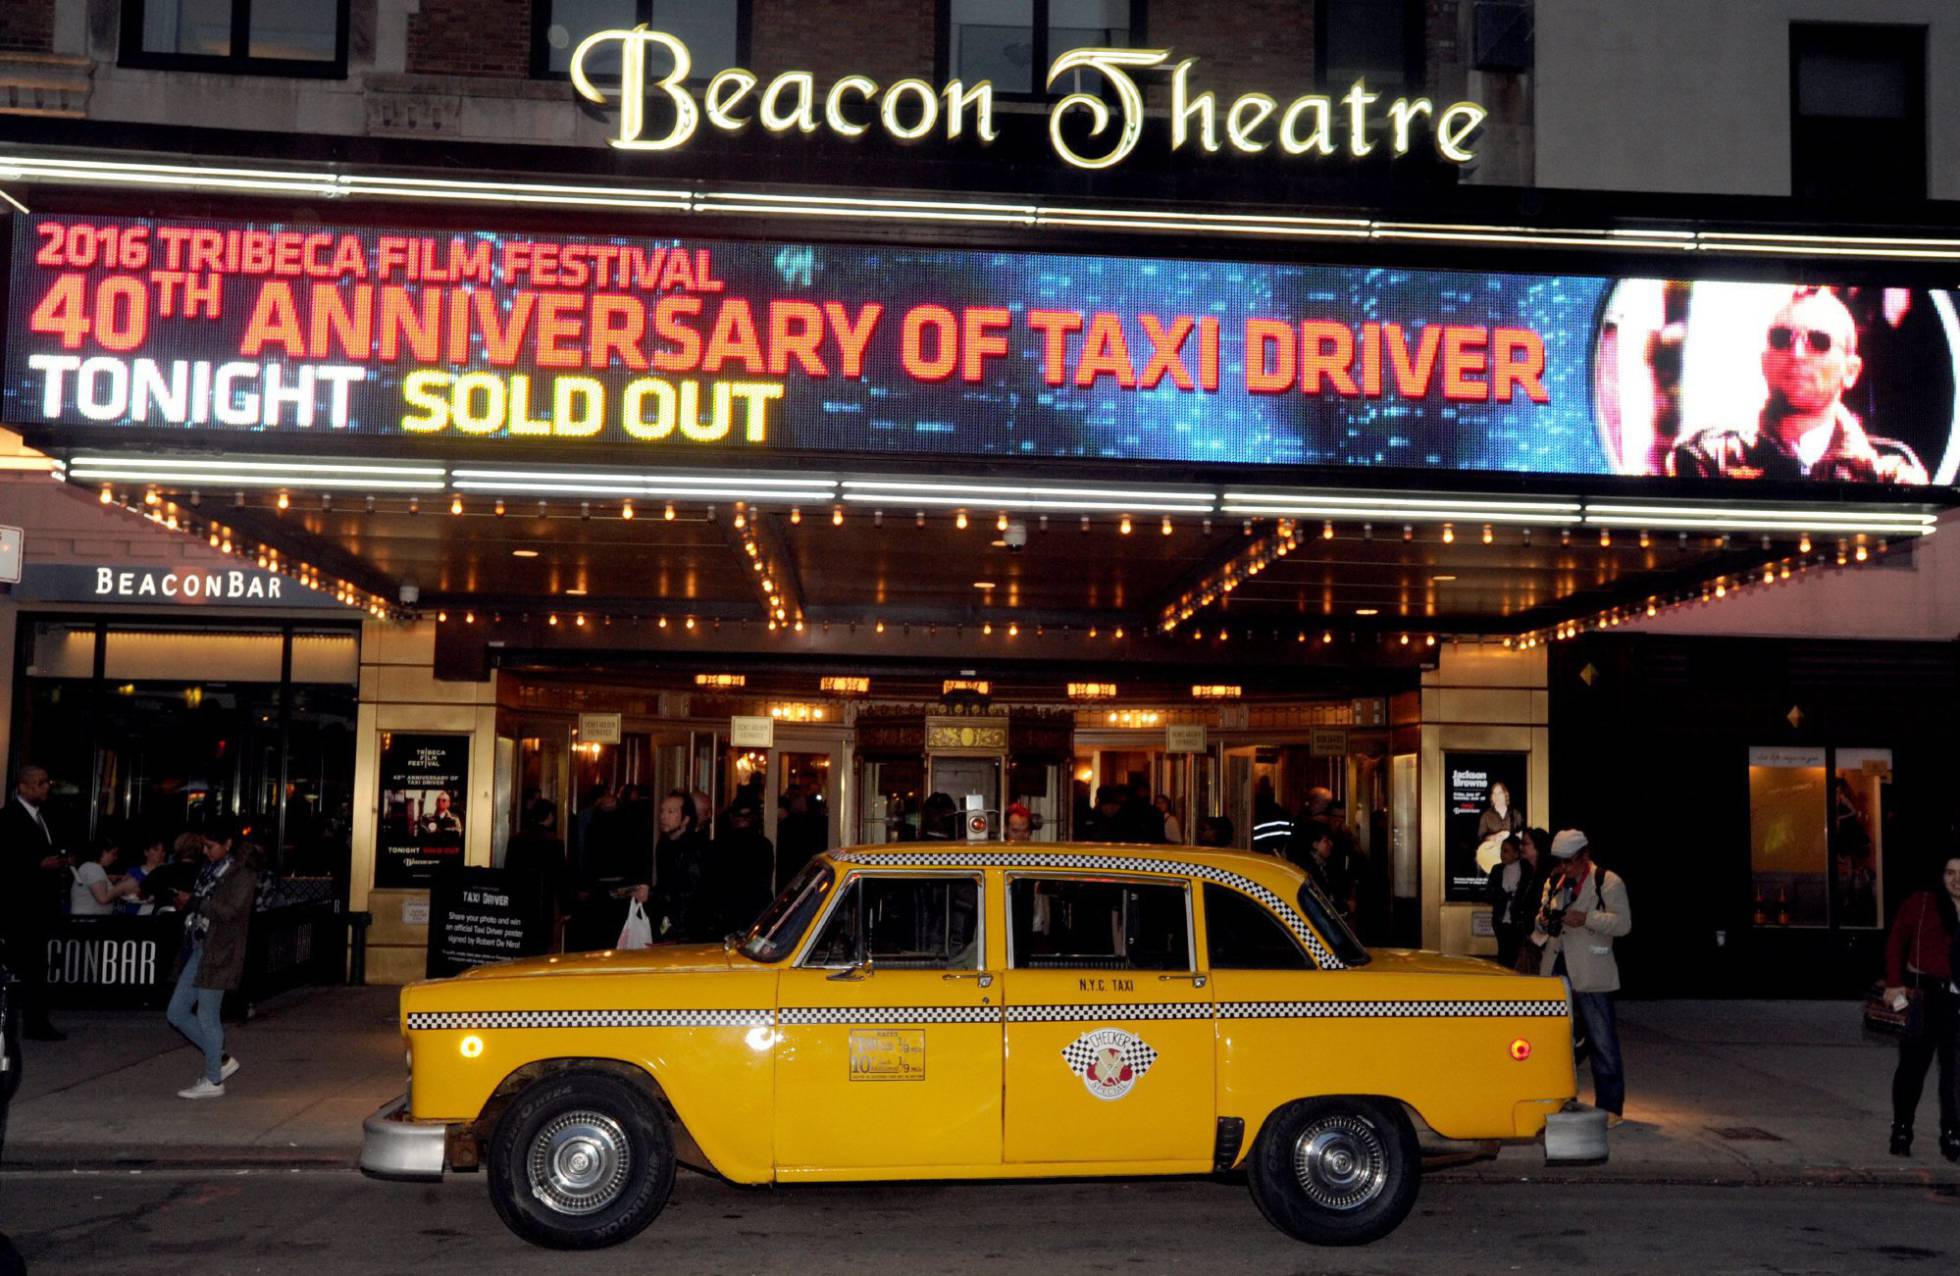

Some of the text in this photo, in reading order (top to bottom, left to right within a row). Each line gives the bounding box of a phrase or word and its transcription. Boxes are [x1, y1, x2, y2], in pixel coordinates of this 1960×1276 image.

[570, 24, 1488, 170] Beacon Theatre
[36, 222, 724, 293] 2016 TRIBECA FILM FESTIVAL
[30, 272, 1551, 404] 40TH ANNIVERSARY OF TAXI DRIVER
[28, 354, 785, 443] TONIGHT SOLD OUT
[1452, 769, 1487, 779] Jackson
[1453, 779, 1488, 787] Browne
[1112, 978, 1134, 992] TAXI
[1089, 1031, 1131, 1049] CHECKER
